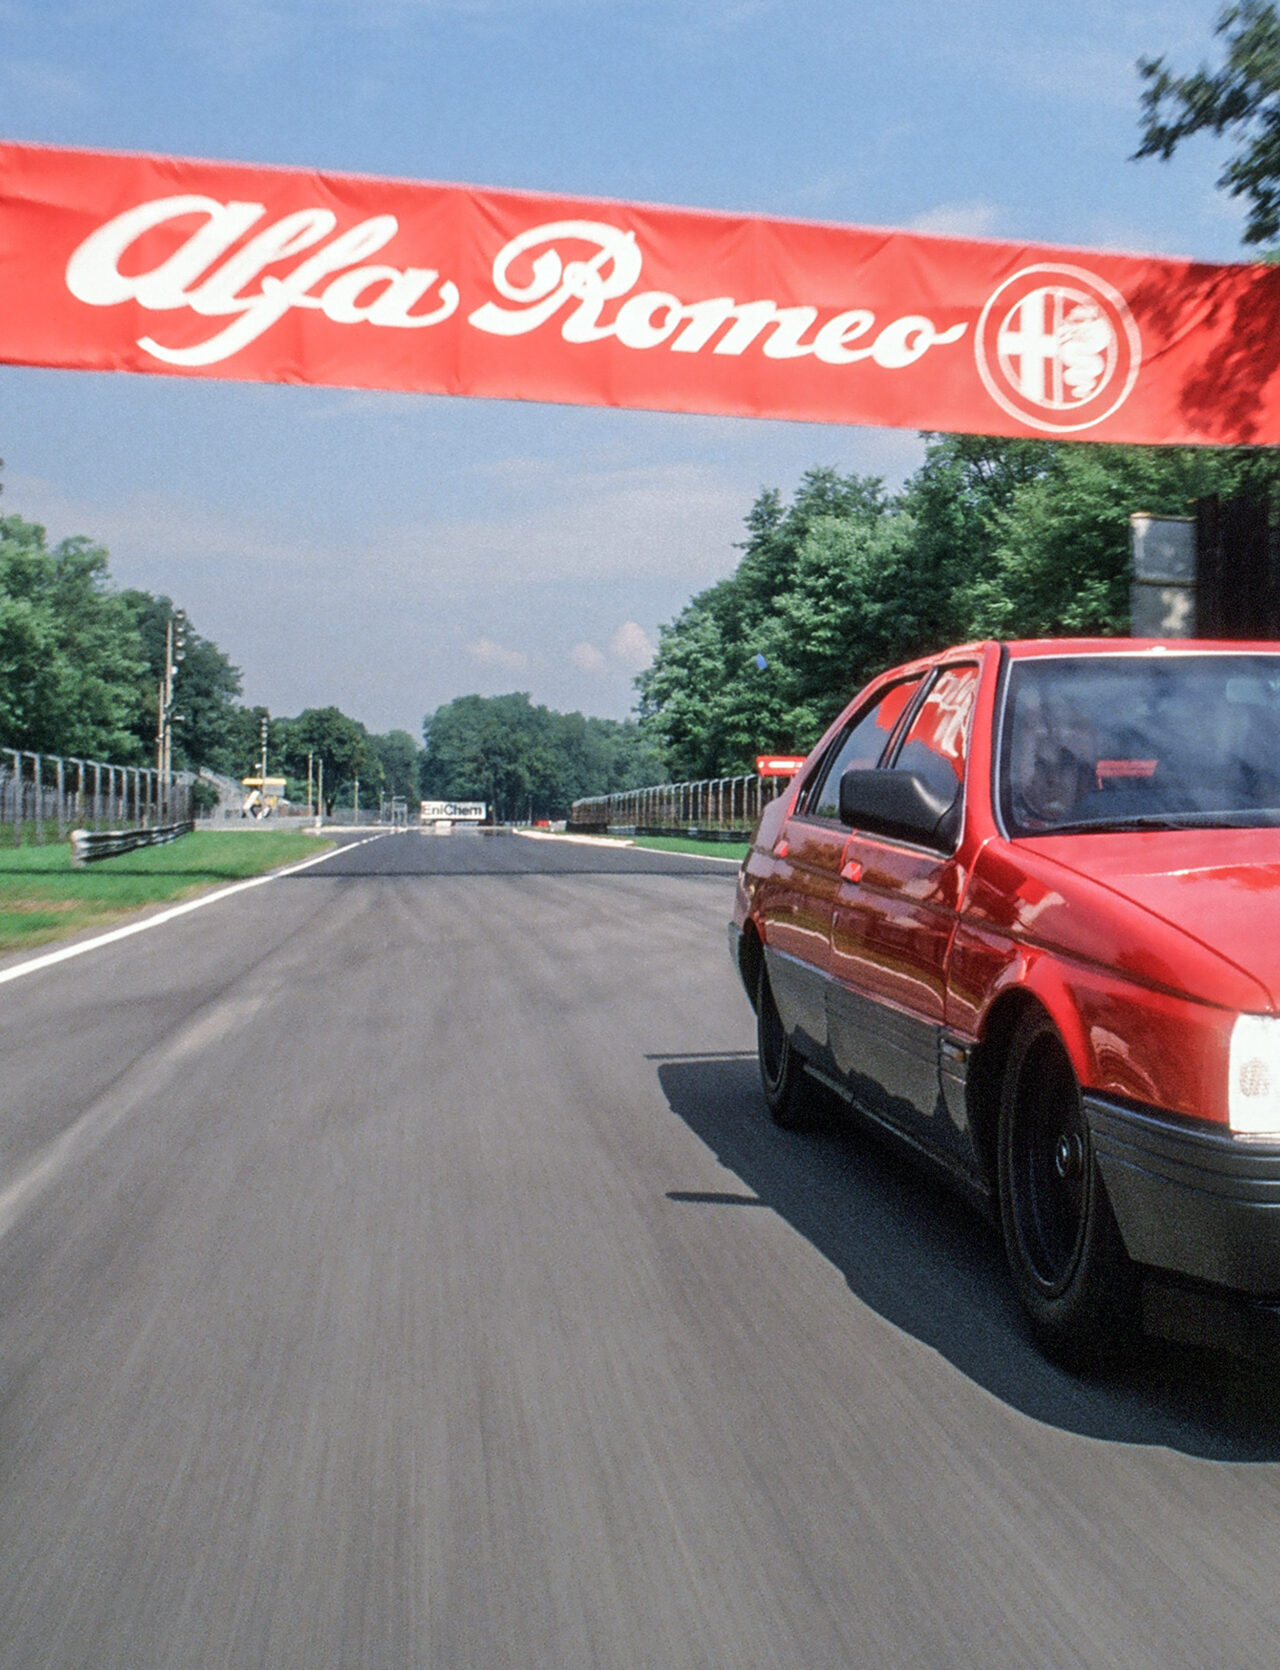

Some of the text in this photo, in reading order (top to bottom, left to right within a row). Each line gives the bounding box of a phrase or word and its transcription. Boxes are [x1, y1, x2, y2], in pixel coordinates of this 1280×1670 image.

[65, 194, 968, 369] Alfa Romeo
[421, 803, 482, 816] EniChem
